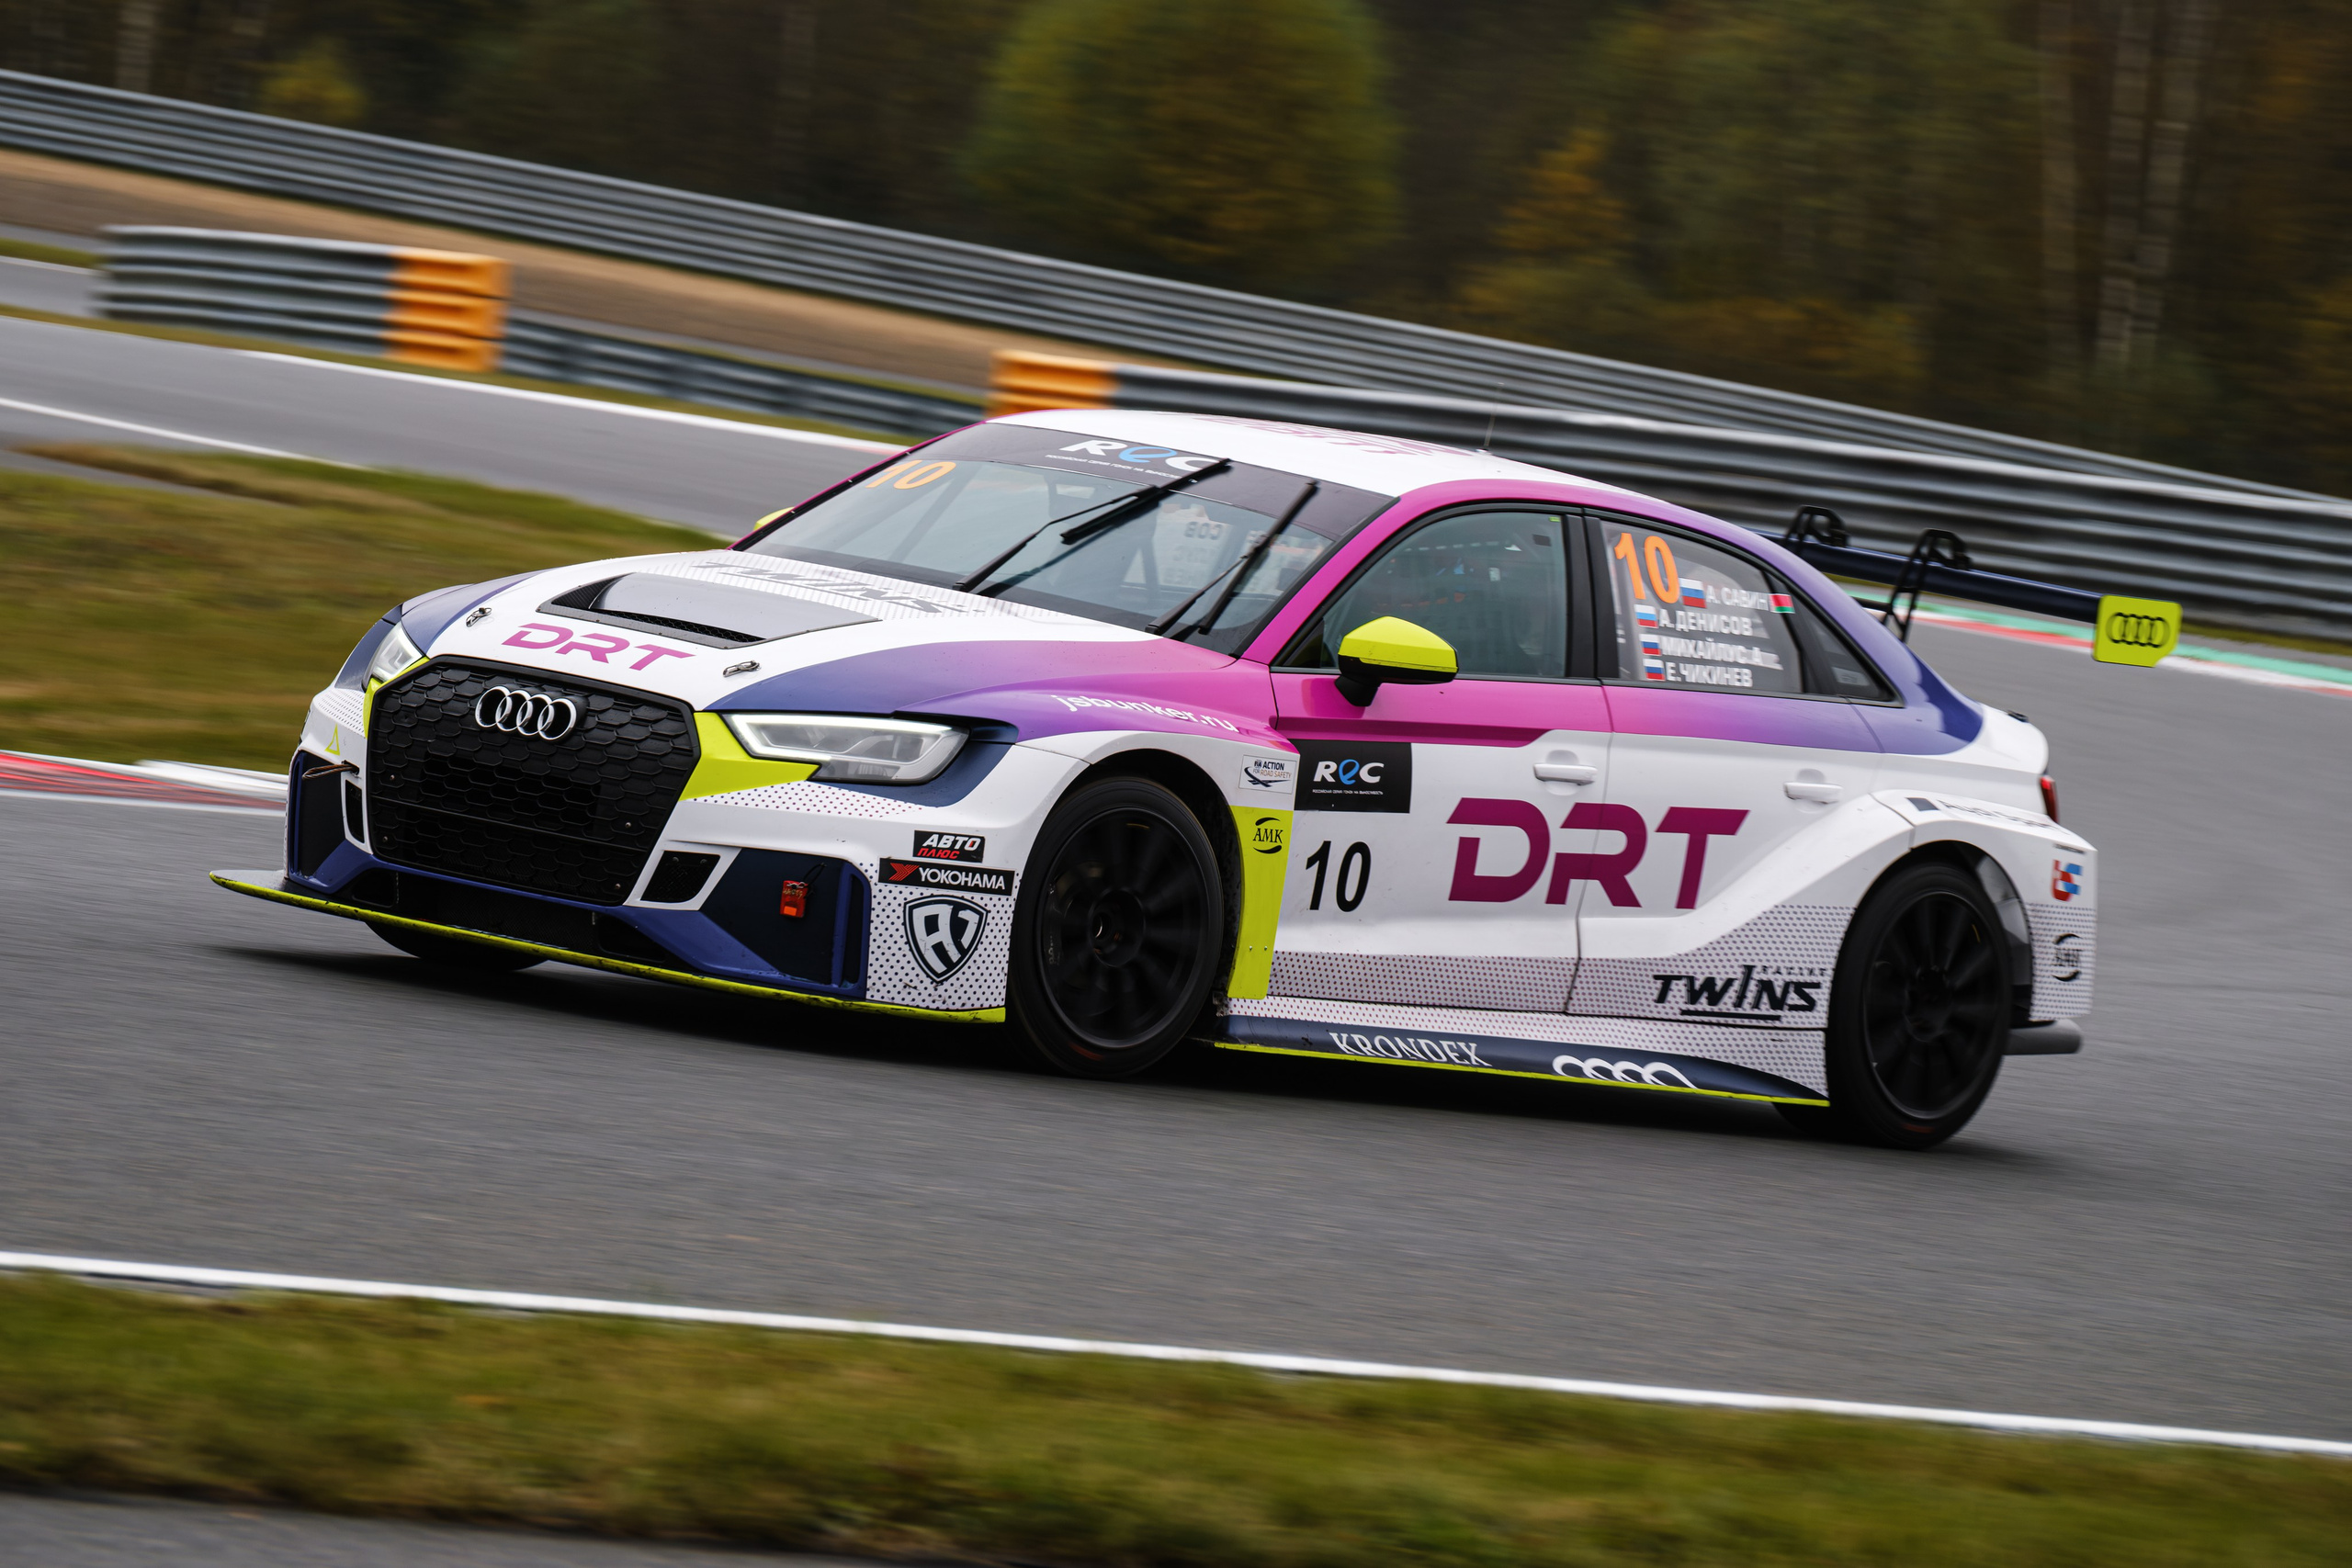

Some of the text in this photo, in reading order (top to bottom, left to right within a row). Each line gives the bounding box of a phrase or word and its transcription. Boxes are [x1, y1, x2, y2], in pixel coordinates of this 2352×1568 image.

[865, 459, 956, 490] 10
[1614, 532, 1680, 604] 10
[502, 623, 695, 671] DRT
[1051, 694, 1239, 733] jsbunker.ru
[1262, 761, 1284, 771] ACTION
[1273, 771, 1292, 779] SAFETY
[917, 847, 960, 860] ПЛЮС
[922, 833, 981, 851] АВТО
[1446, 797, 1750, 909] DRT
[919, 867, 1006, 890] YOKOHAMA
[1306, 840, 1372, 913] 10
[1653, 964, 1821, 1012] TWINS
[1329, 1032, 1493, 1067] KRONDEX
